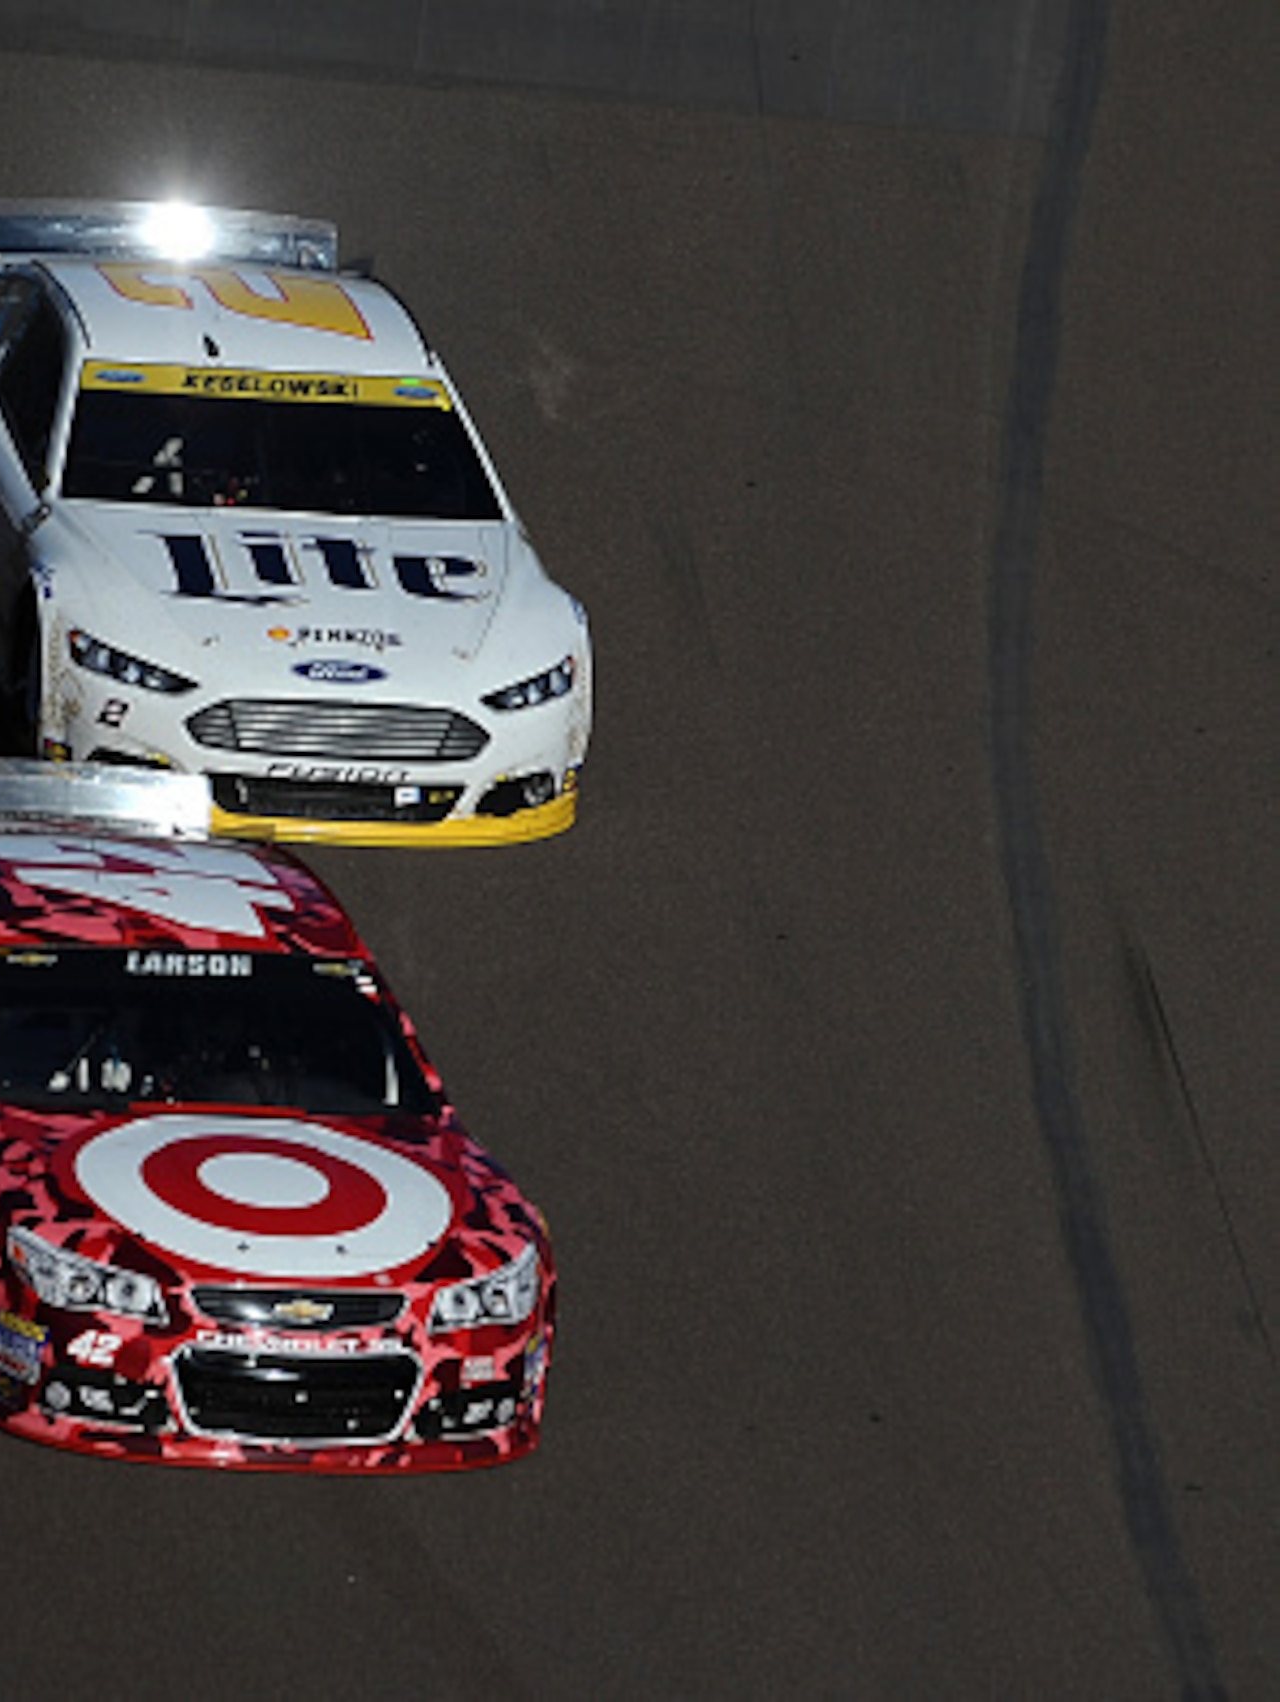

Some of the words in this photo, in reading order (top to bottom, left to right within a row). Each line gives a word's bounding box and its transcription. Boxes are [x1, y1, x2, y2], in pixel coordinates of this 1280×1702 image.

[181, 373, 360, 398] KESELOWSKI
[138, 529, 492, 605] Lite
[126, 951, 253, 978] LARSON
[66, 1328, 123, 1369] 42
